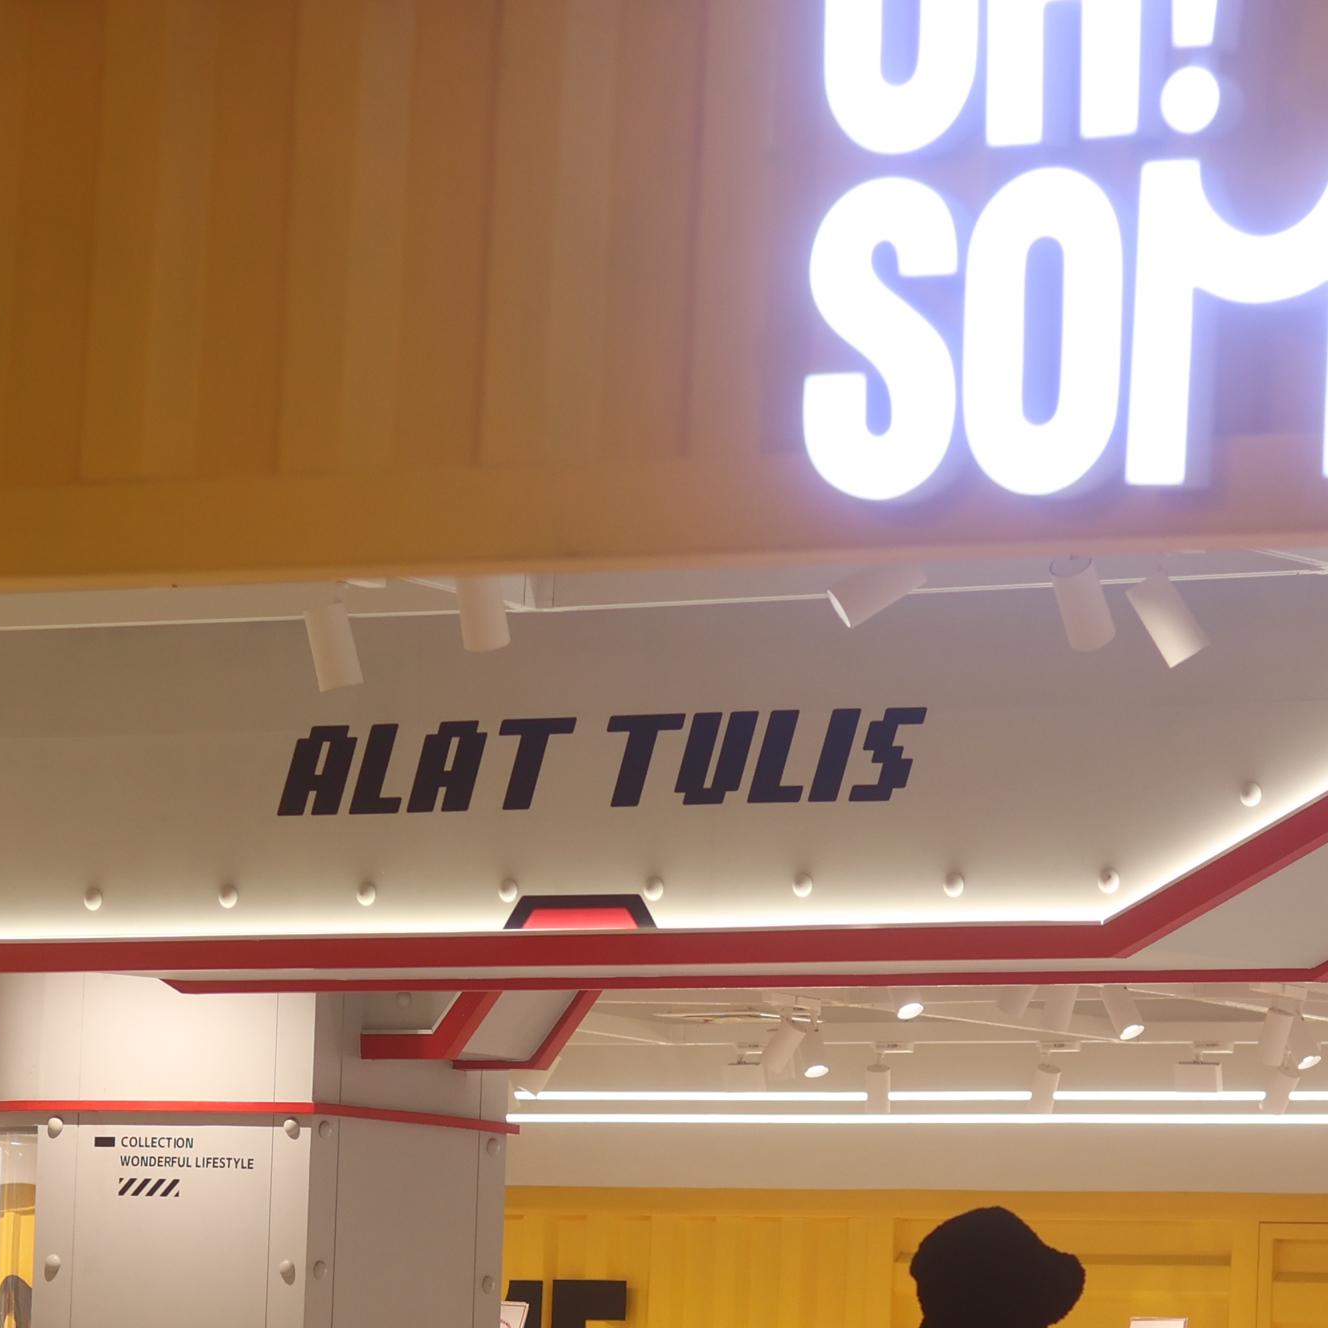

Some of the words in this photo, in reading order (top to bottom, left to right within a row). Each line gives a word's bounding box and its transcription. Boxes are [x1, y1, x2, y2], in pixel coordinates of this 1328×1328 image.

[276, 716, 577, 817] ALAT
[606, 706, 928, 808] TULIS
[120, 1136, 194, 1149] COLLECTION
[120, 1155, 192, 1168] WONDERFUL
[195, 1156, 255, 1170] LIFESTYLE
